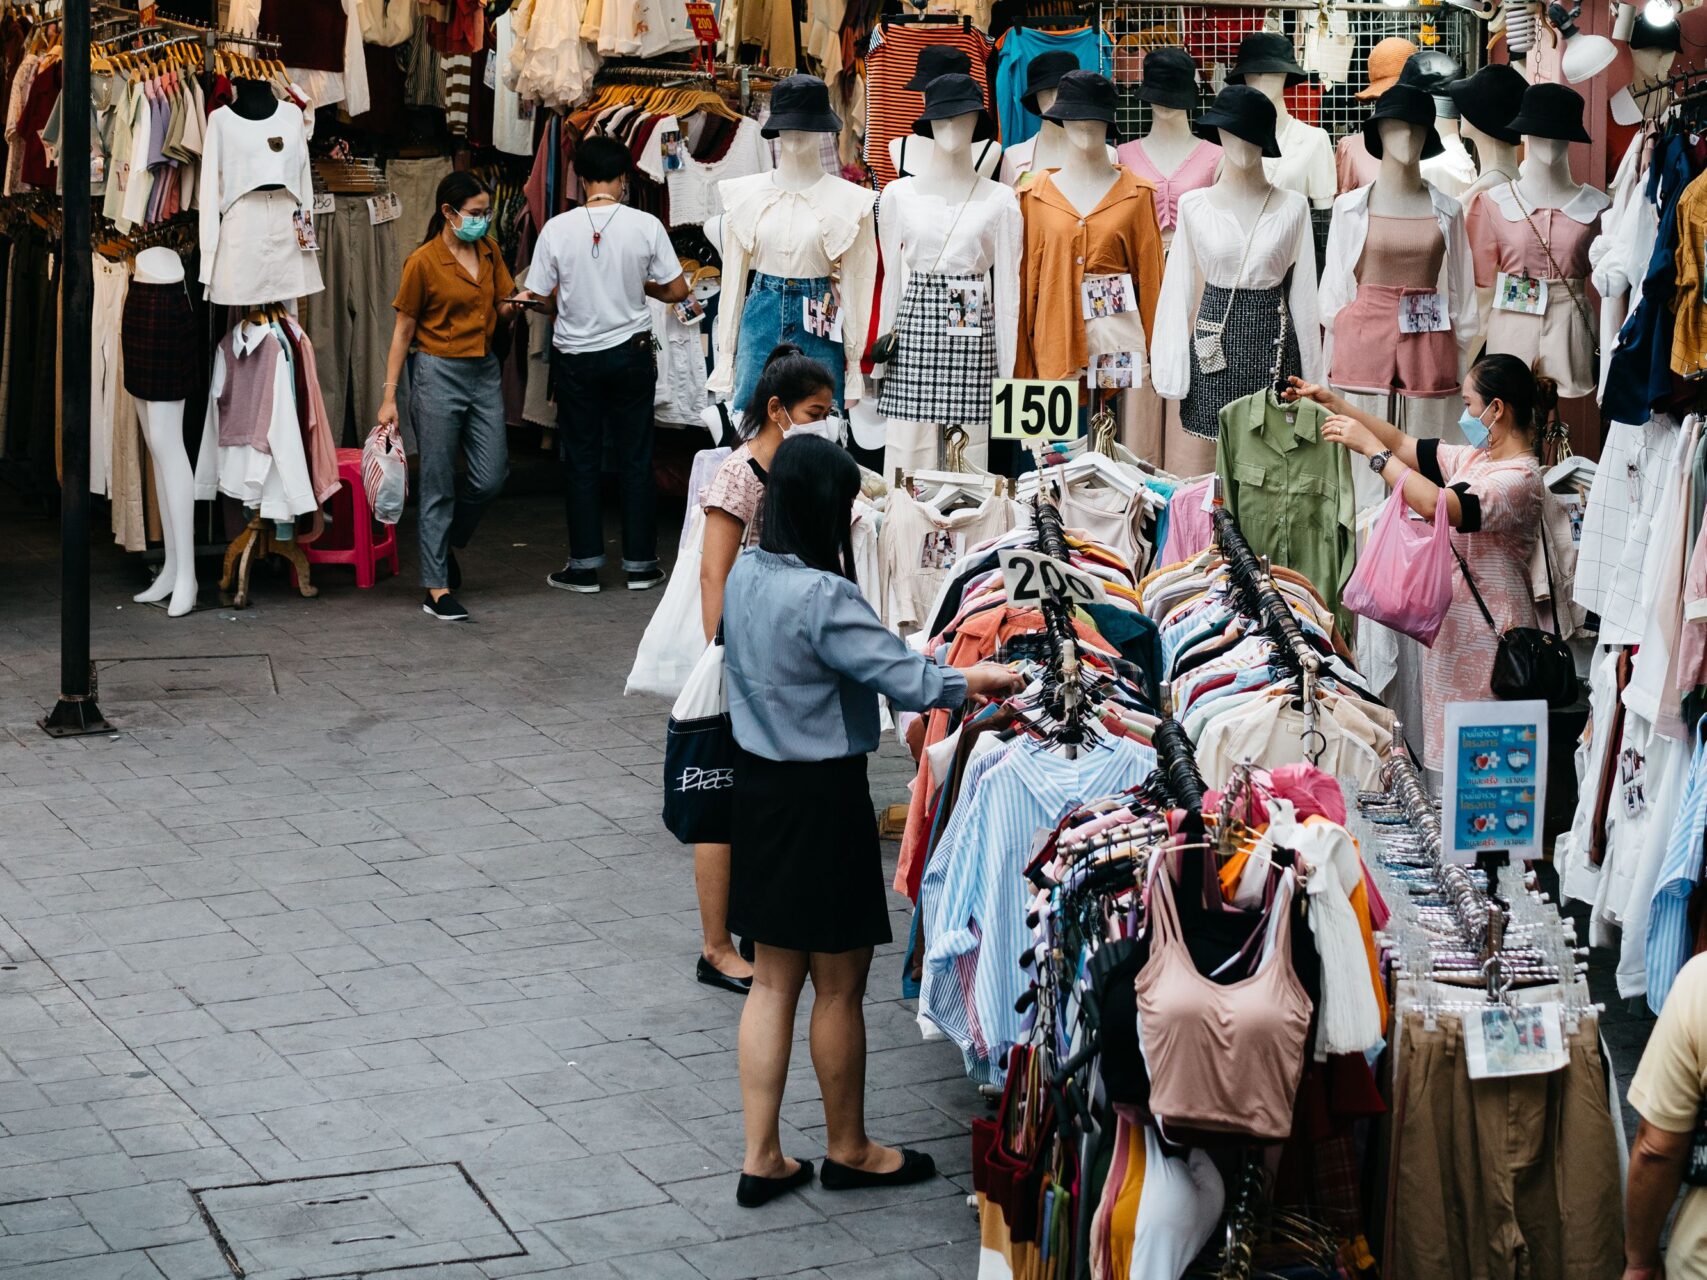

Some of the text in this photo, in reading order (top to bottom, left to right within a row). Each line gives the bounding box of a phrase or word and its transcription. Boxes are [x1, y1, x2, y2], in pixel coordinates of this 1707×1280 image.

[695, 17, 713, 30] 200
[995, 383, 1072, 436] 150
[1008, 556, 1095, 601] 200
